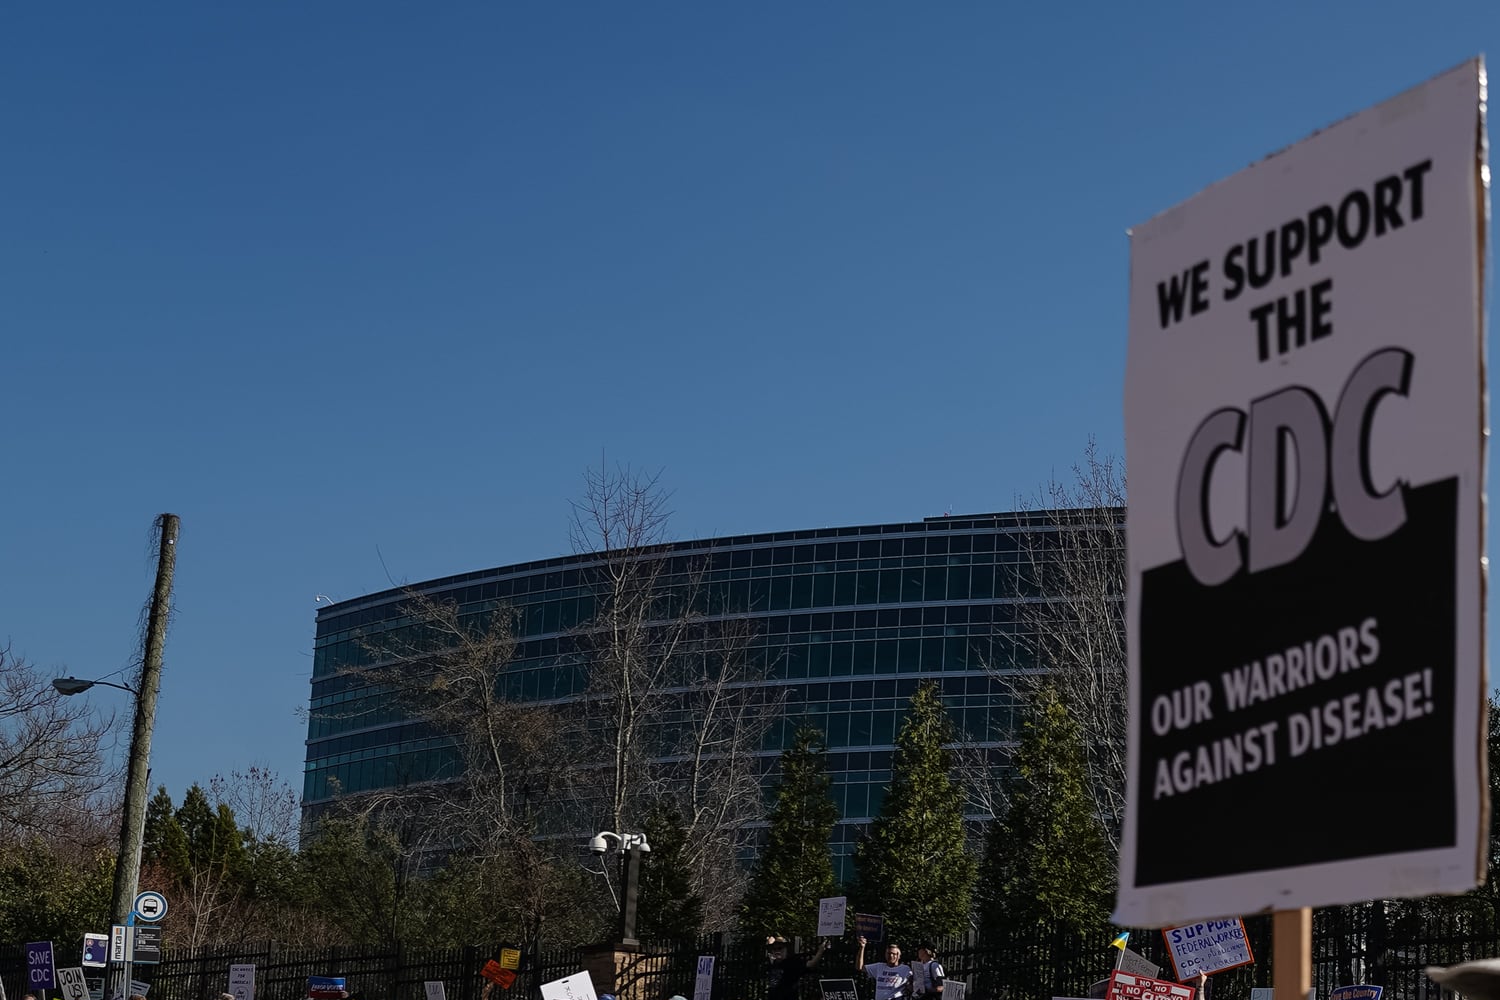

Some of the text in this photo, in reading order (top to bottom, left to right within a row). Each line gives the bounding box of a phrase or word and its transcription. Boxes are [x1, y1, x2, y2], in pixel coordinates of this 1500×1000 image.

[1157, 160, 1432, 328] WE SUPPORT
[1251, 279, 1333, 362] THE
[1177, 347, 1415, 585] CDC
[1153, 619, 1380, 736] OUR WARRIORS
[1155, 669, 1434, 800] AGAINST DISEASE!
[28, 950, 50, 965] SAVE
[30, 969, 50, 983] CDC
[60, 968, 82, 986] JOIN
[825, 991, 856, 1000] SAVE THE
[1126, 987, 1140, 995] NO
[1353, 989, 1377, 999] Country
